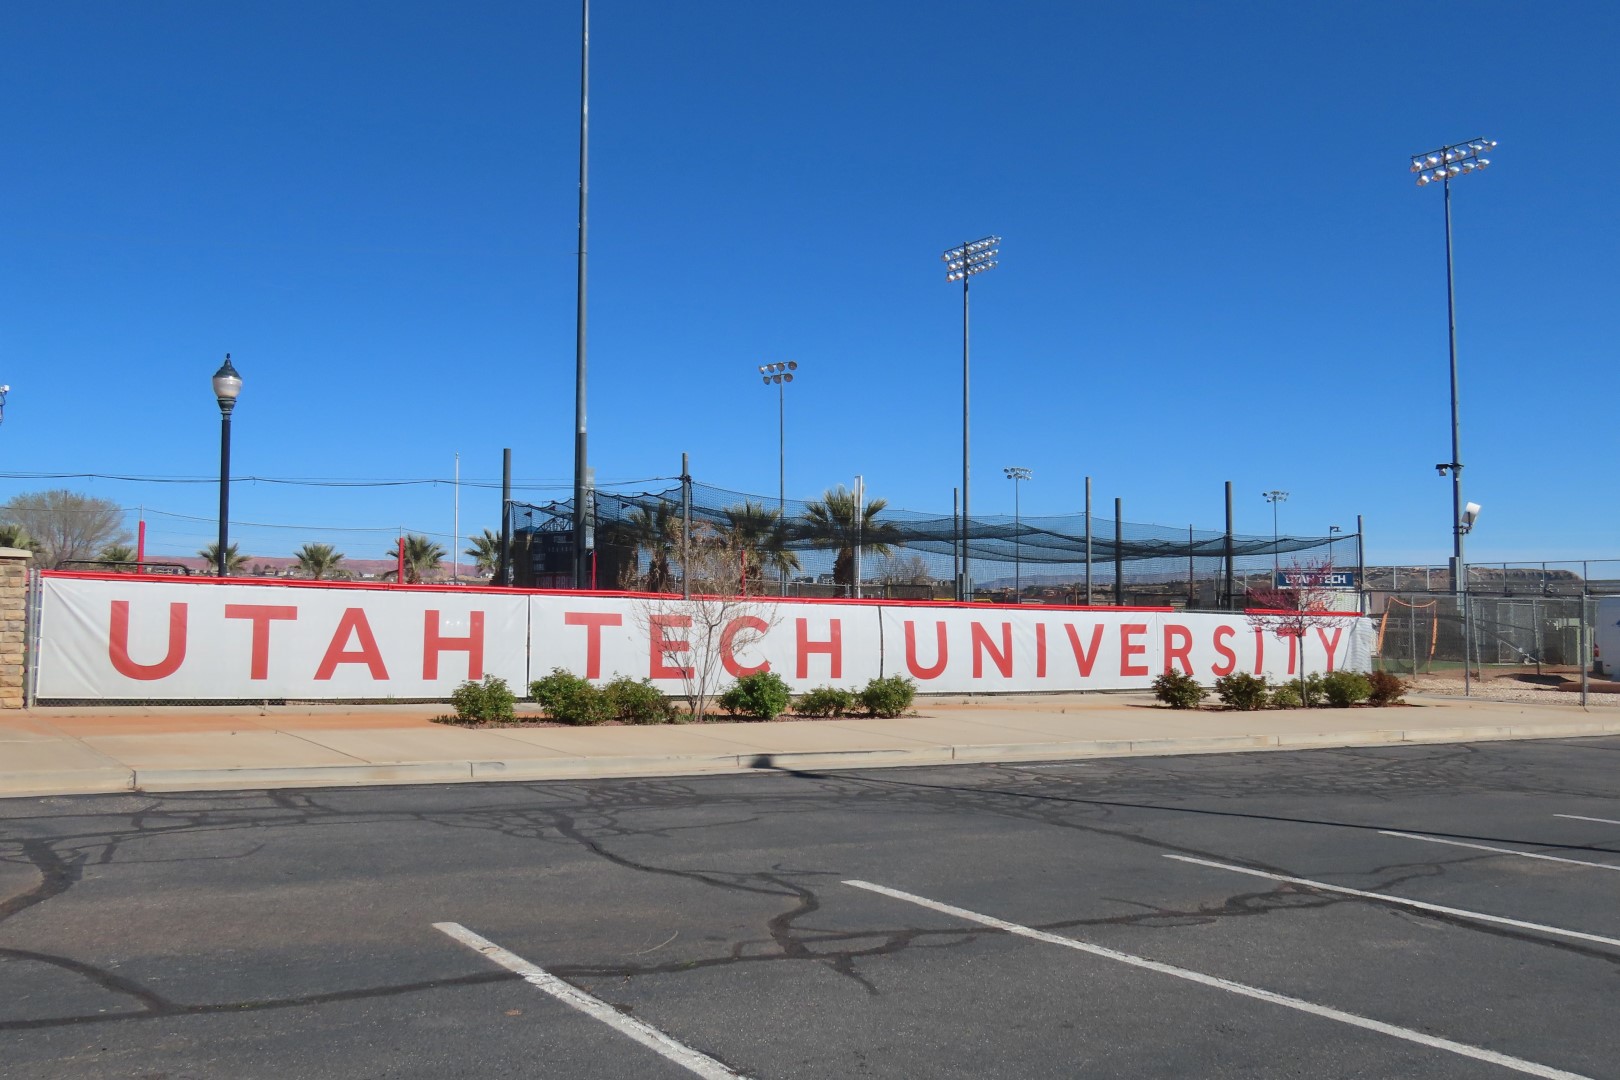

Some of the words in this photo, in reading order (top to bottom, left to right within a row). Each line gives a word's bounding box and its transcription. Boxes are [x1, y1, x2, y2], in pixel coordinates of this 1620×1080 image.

[1317, 574, 1346, 583] TECH
[108, 600, 485, 681] UTAH
[564, 612, 841, 679] TECH
[904, 621, 1342, 679] UNIVERSITY
